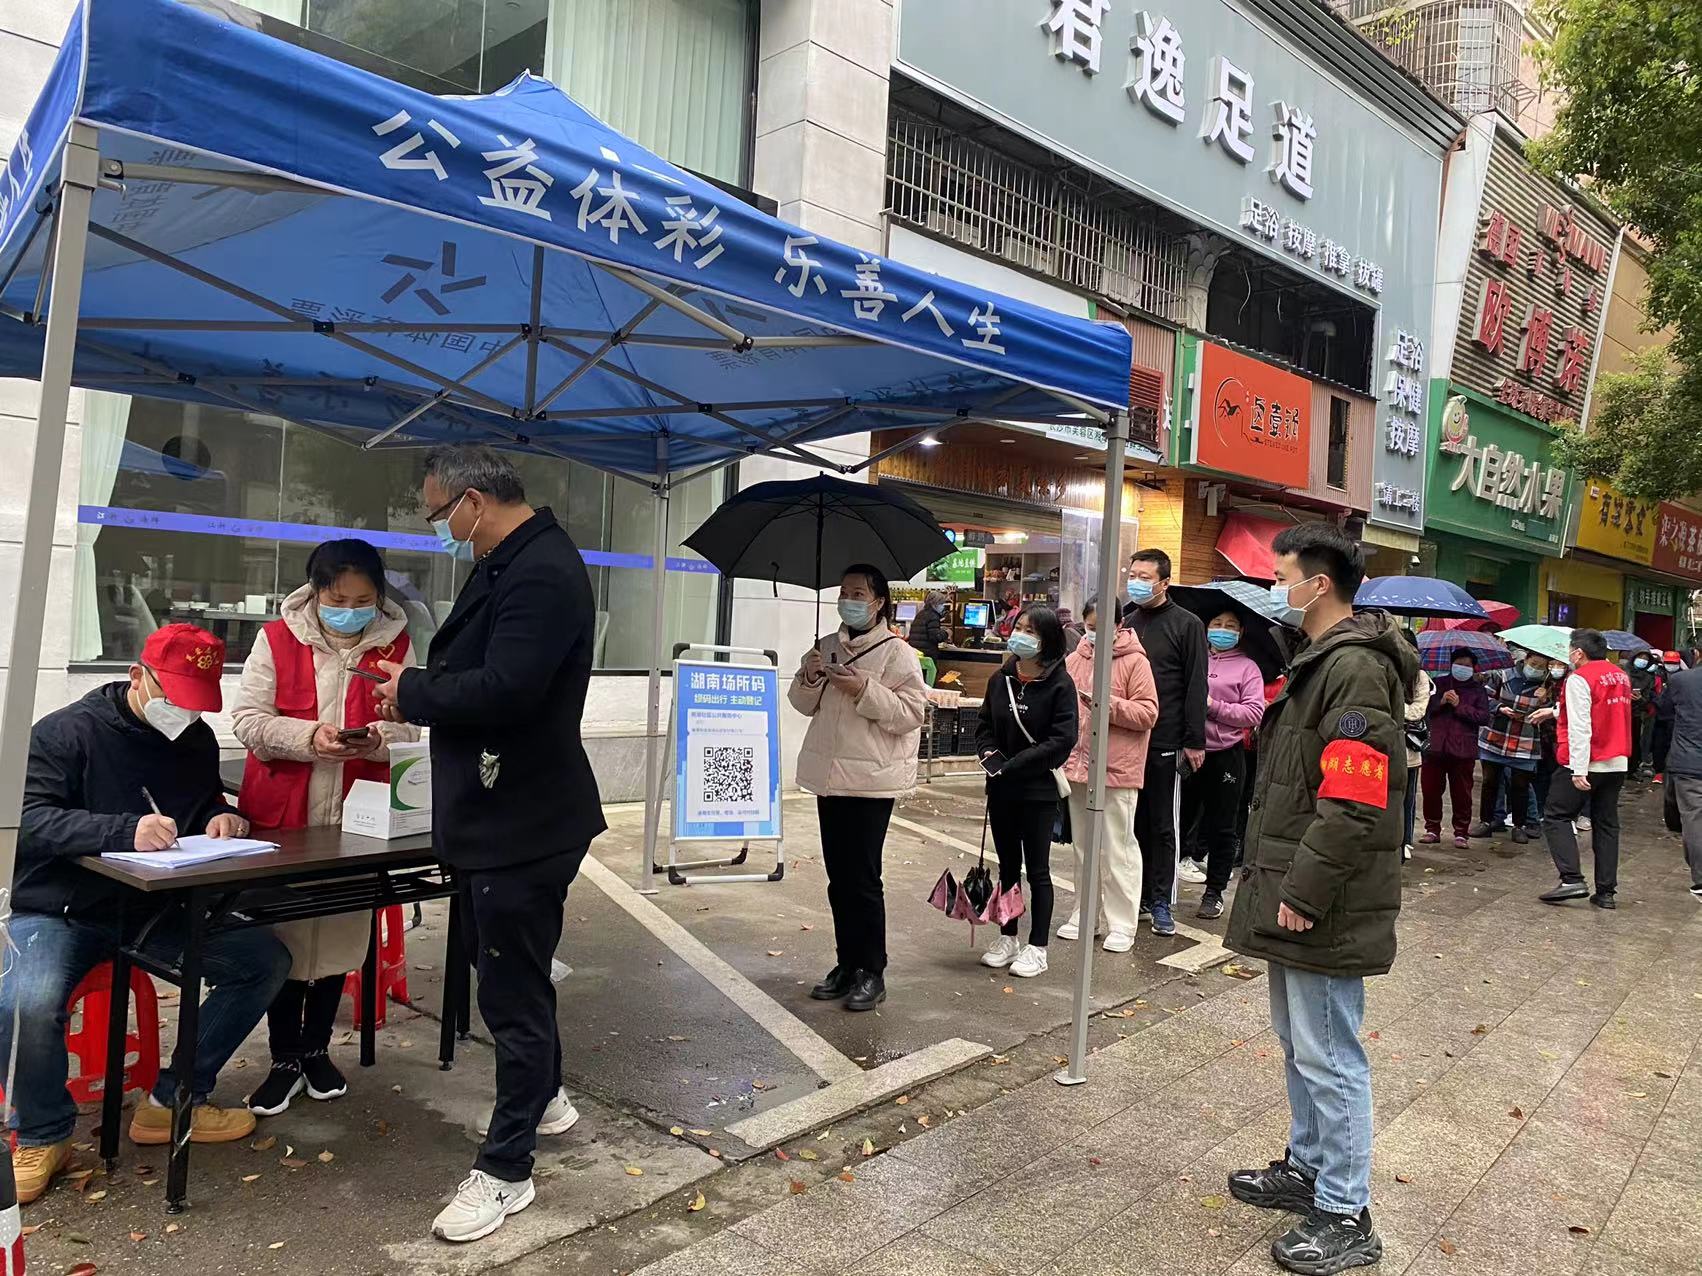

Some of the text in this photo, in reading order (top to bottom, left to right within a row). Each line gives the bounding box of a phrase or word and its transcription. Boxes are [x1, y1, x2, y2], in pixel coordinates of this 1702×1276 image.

[372, 109, 1006, 355] 公益体彩 乐善人生
[1243, 197, 1384, 293] 足浴 按摩 推拿 拔罐
[1386, 329, 1424, 372] 足浴
[1385, 370, 1423, 415] 保健
[1387, 415, 1420, 457] 按摩
[1446, 436, 1566, 519] 大自然水果
[690, 672, 766, 692] 湖南场所码
[730, 695, 763, 706] 主动登记
